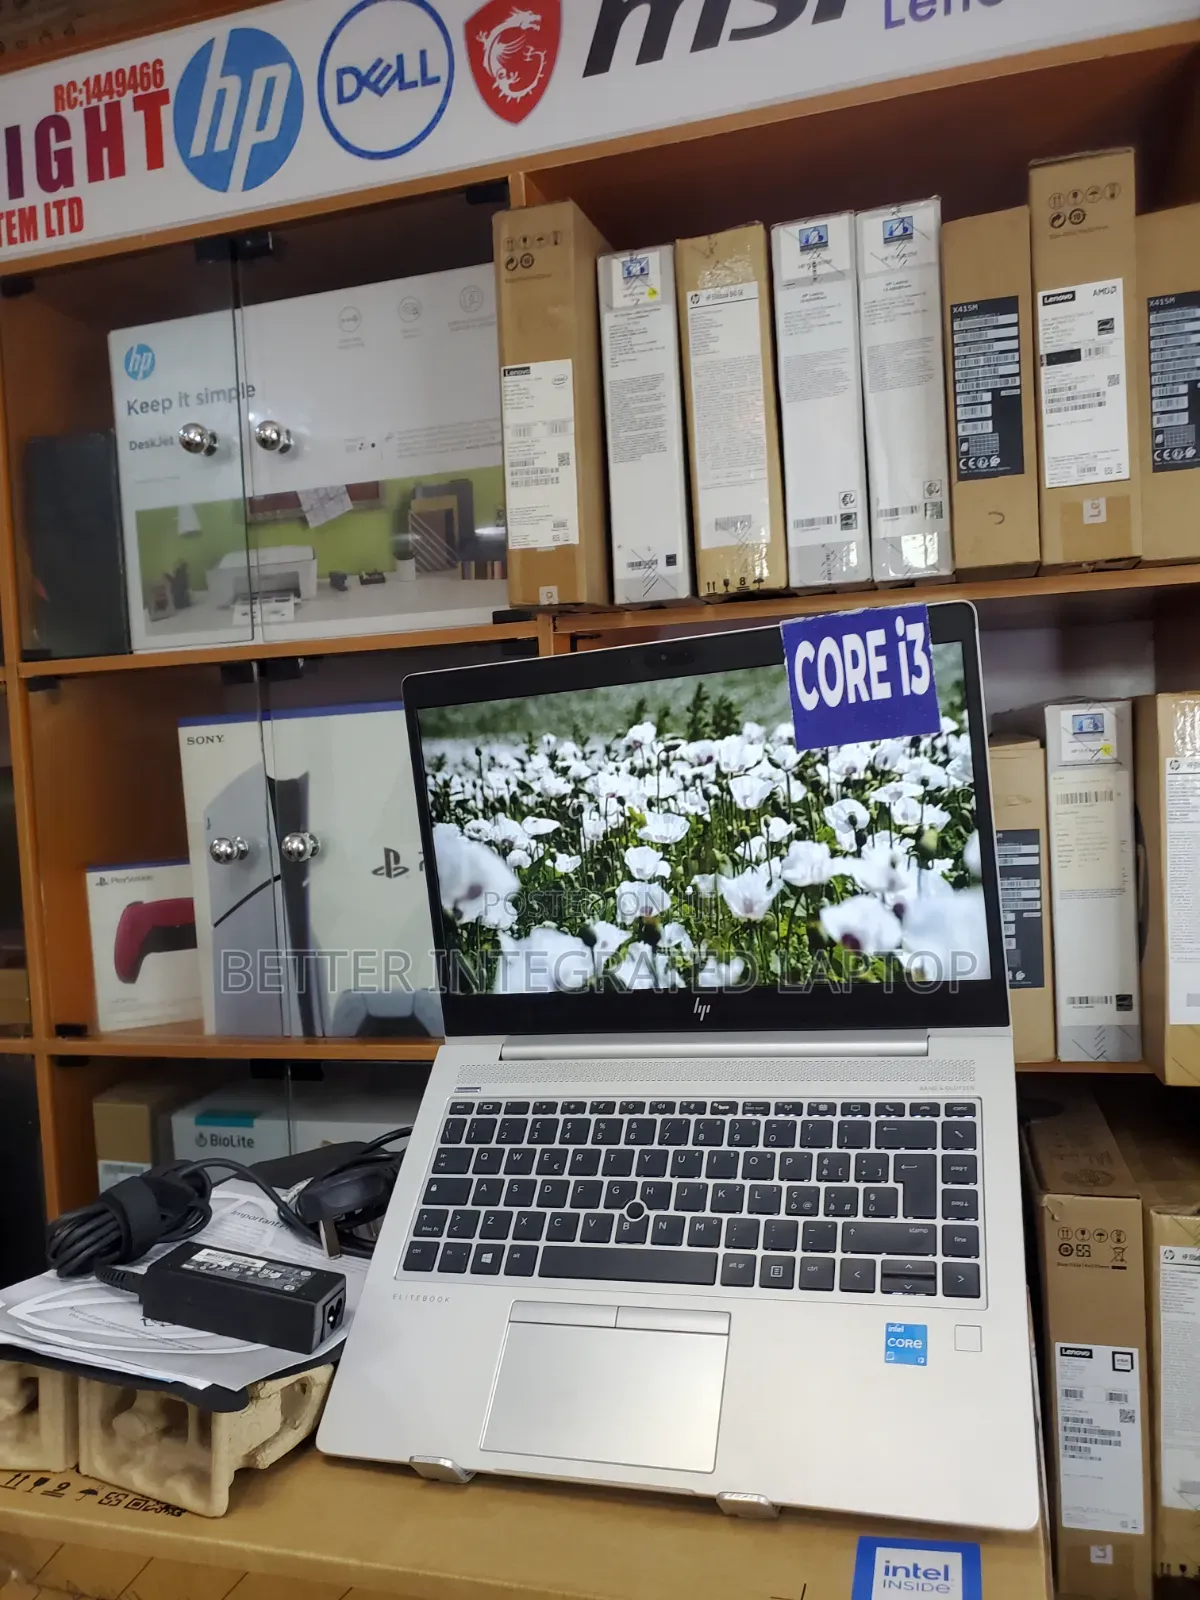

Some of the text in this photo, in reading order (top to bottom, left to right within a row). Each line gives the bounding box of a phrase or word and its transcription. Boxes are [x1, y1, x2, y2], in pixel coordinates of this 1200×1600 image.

[884, 0, 1003, 29] Len
[54, 58, 165, 113] RC:1449466
[337, 48, 441, 104] DELL
[189, 29, 291, 191] hp
[4, 88, 171, 200] IGHT
[0, 196, 84, 246] EM LTD
[1044, 293, 1073, 304] Lenovo
[504, 368, 530, 377] Lenovo
[127, 382, 256, 416] Keep it simple
[129, 436, 174, 451] DeskJet
[794, 615, 931, 712] CORE i3
[186, 734, 225, 746] SONY
[209, 1133, 255, 1149] BioLite
[231, 1210, 279, 1227] Important
[392, 1293, 451, 1303] ELITEBOOK
[888, 1324, 905, 1333] intel
[1061, 1349, 1091, 1357] Lenovo
[883, 1560, 950, 1582] intel
